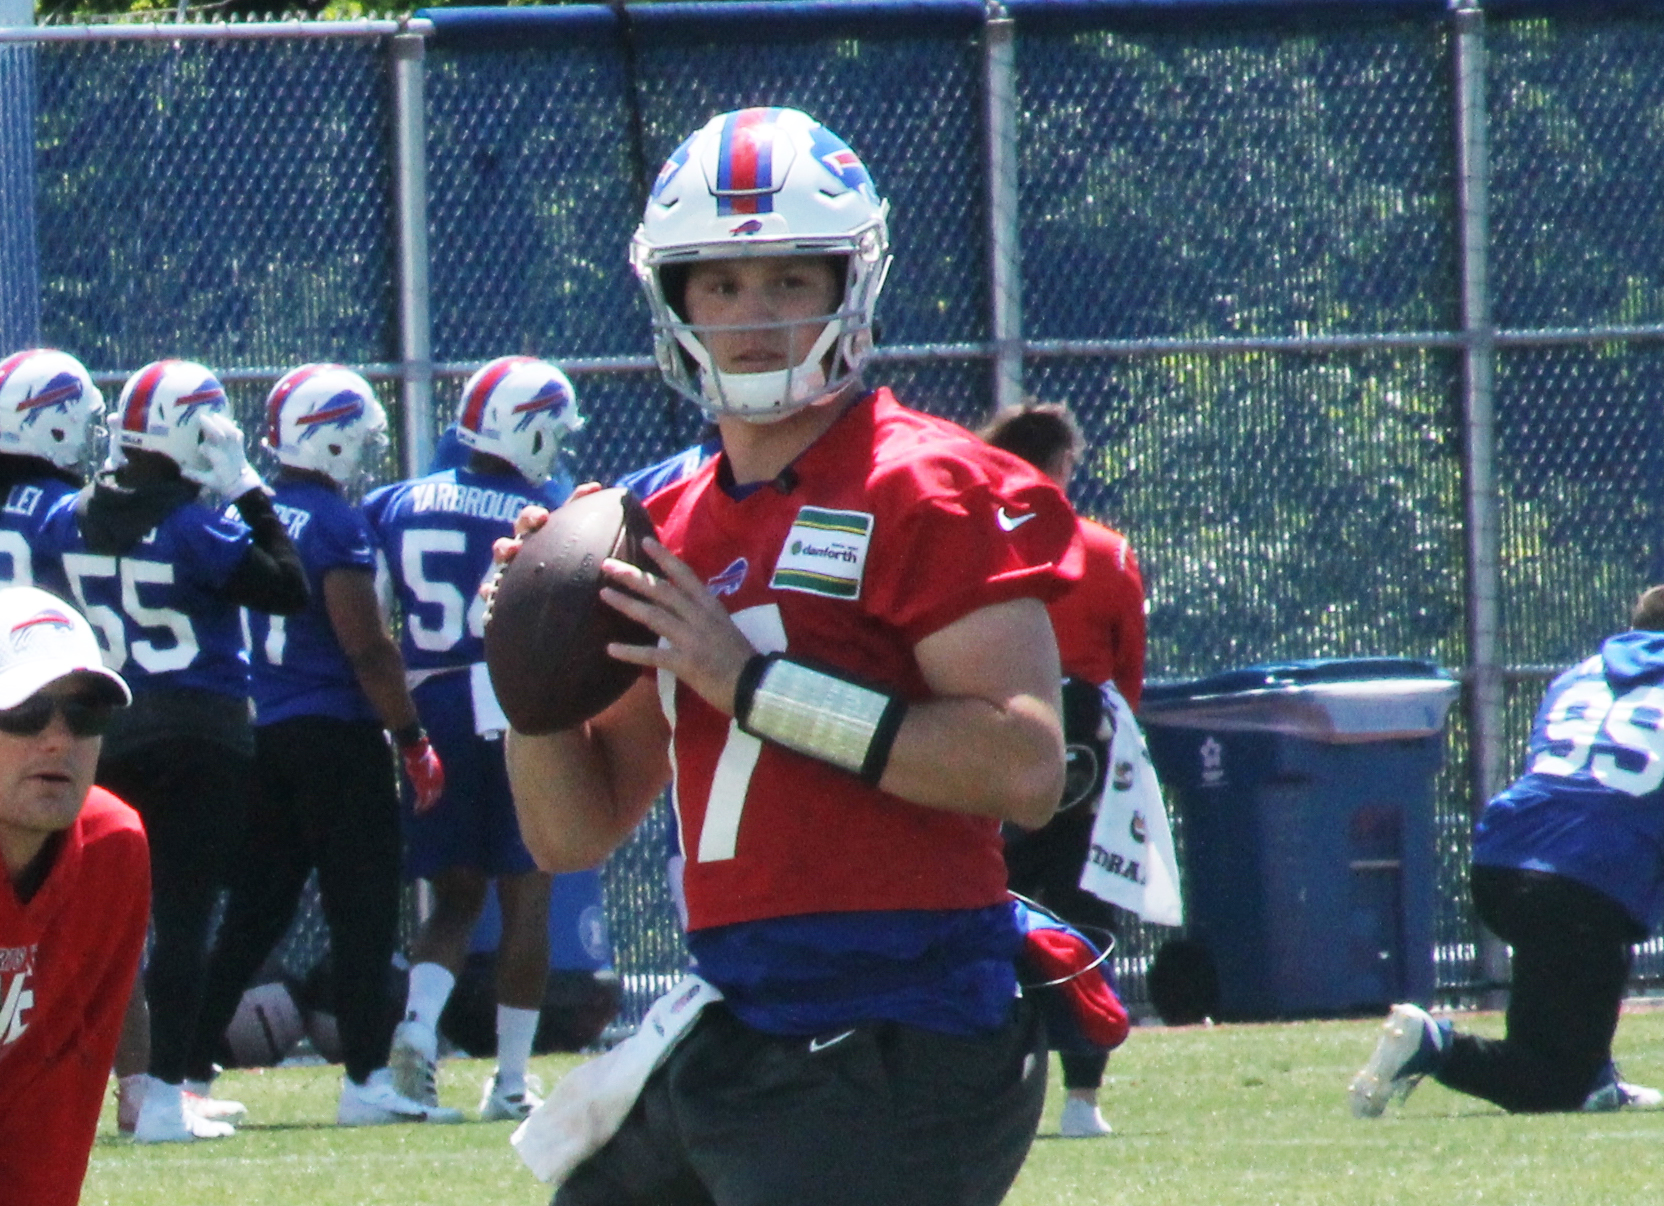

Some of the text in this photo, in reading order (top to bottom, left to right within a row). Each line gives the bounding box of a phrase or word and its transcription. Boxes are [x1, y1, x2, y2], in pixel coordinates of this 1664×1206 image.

[411, 483, 542, 523] YARBROUG
[802, 544, 858, 564] danforth
[61, 552, 200, 674] 55
